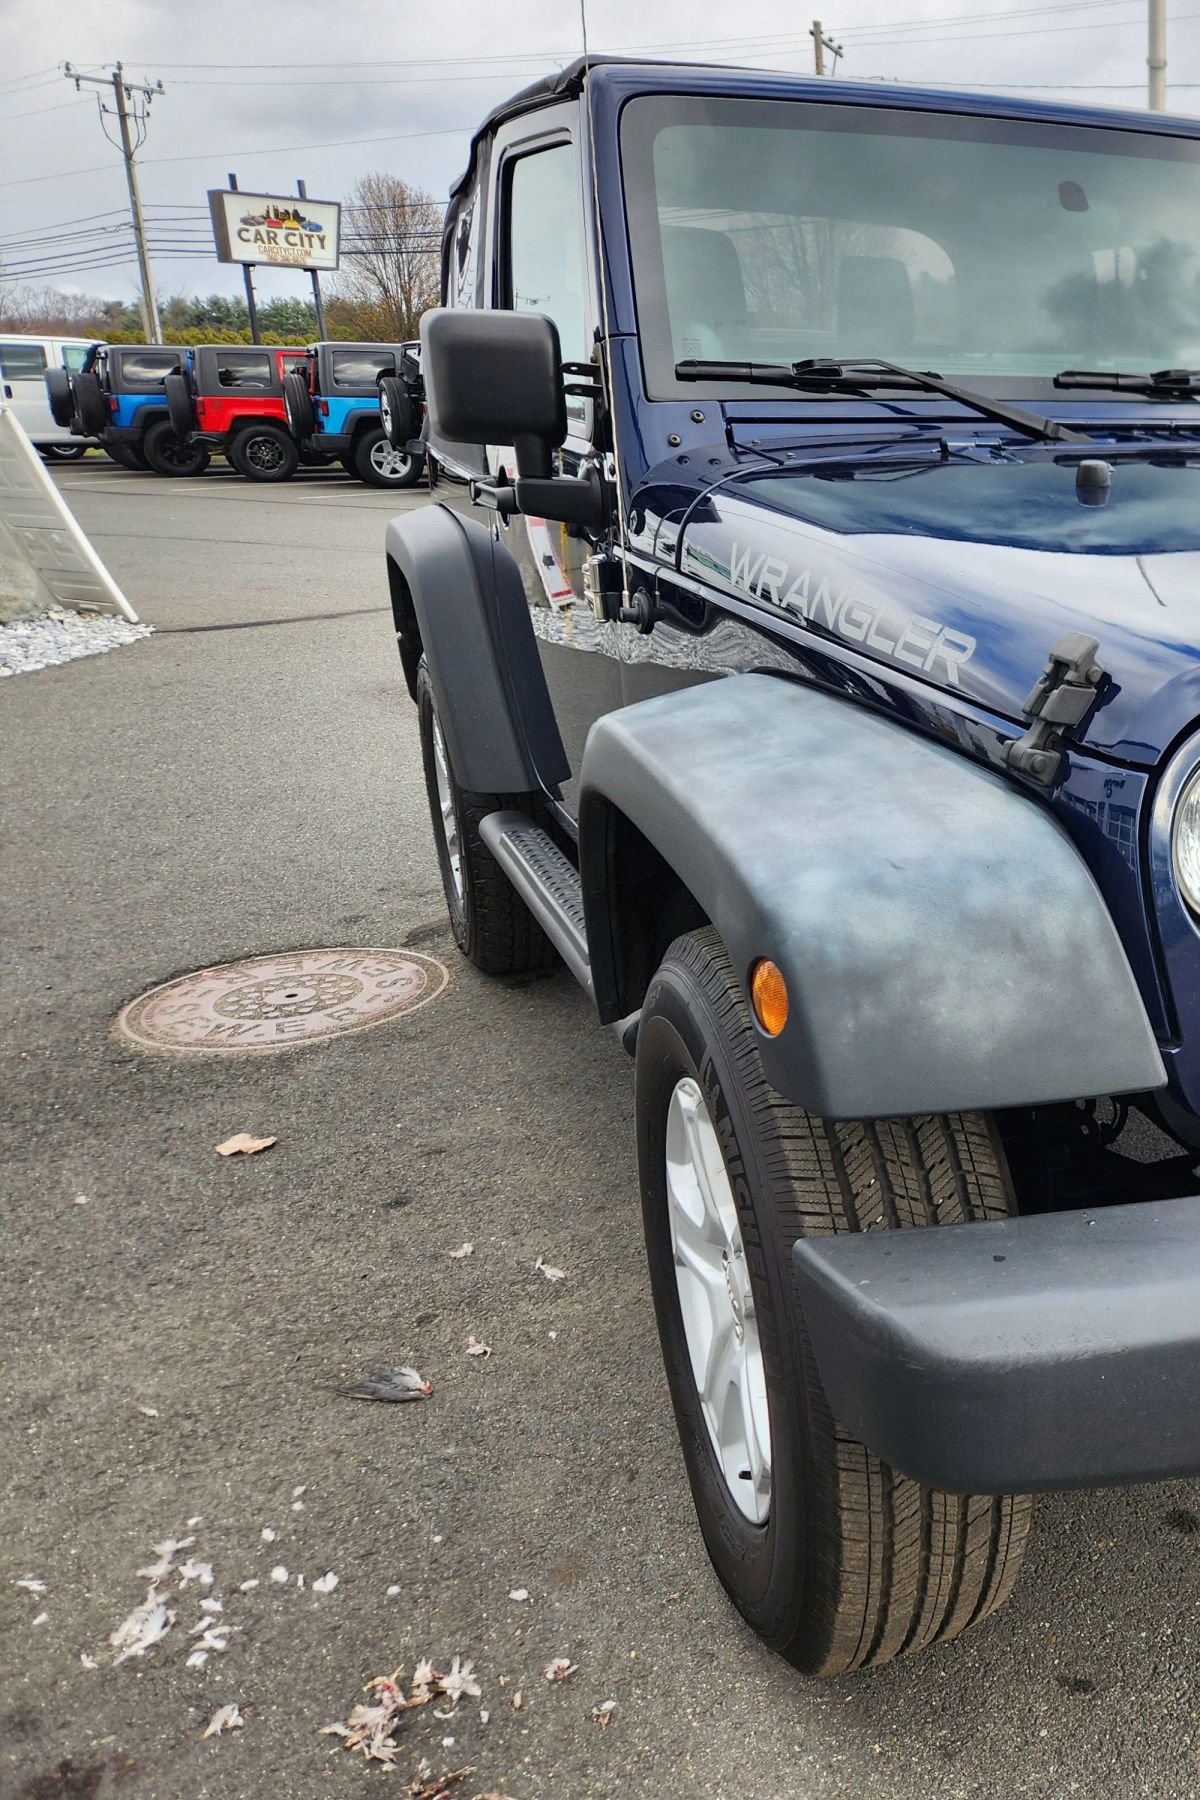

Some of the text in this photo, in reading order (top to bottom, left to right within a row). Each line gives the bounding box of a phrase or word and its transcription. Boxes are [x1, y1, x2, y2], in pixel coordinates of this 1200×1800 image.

[237, 227, 327, 249] CAR CITY
[730, 542, 977, 685] WRANGLER
